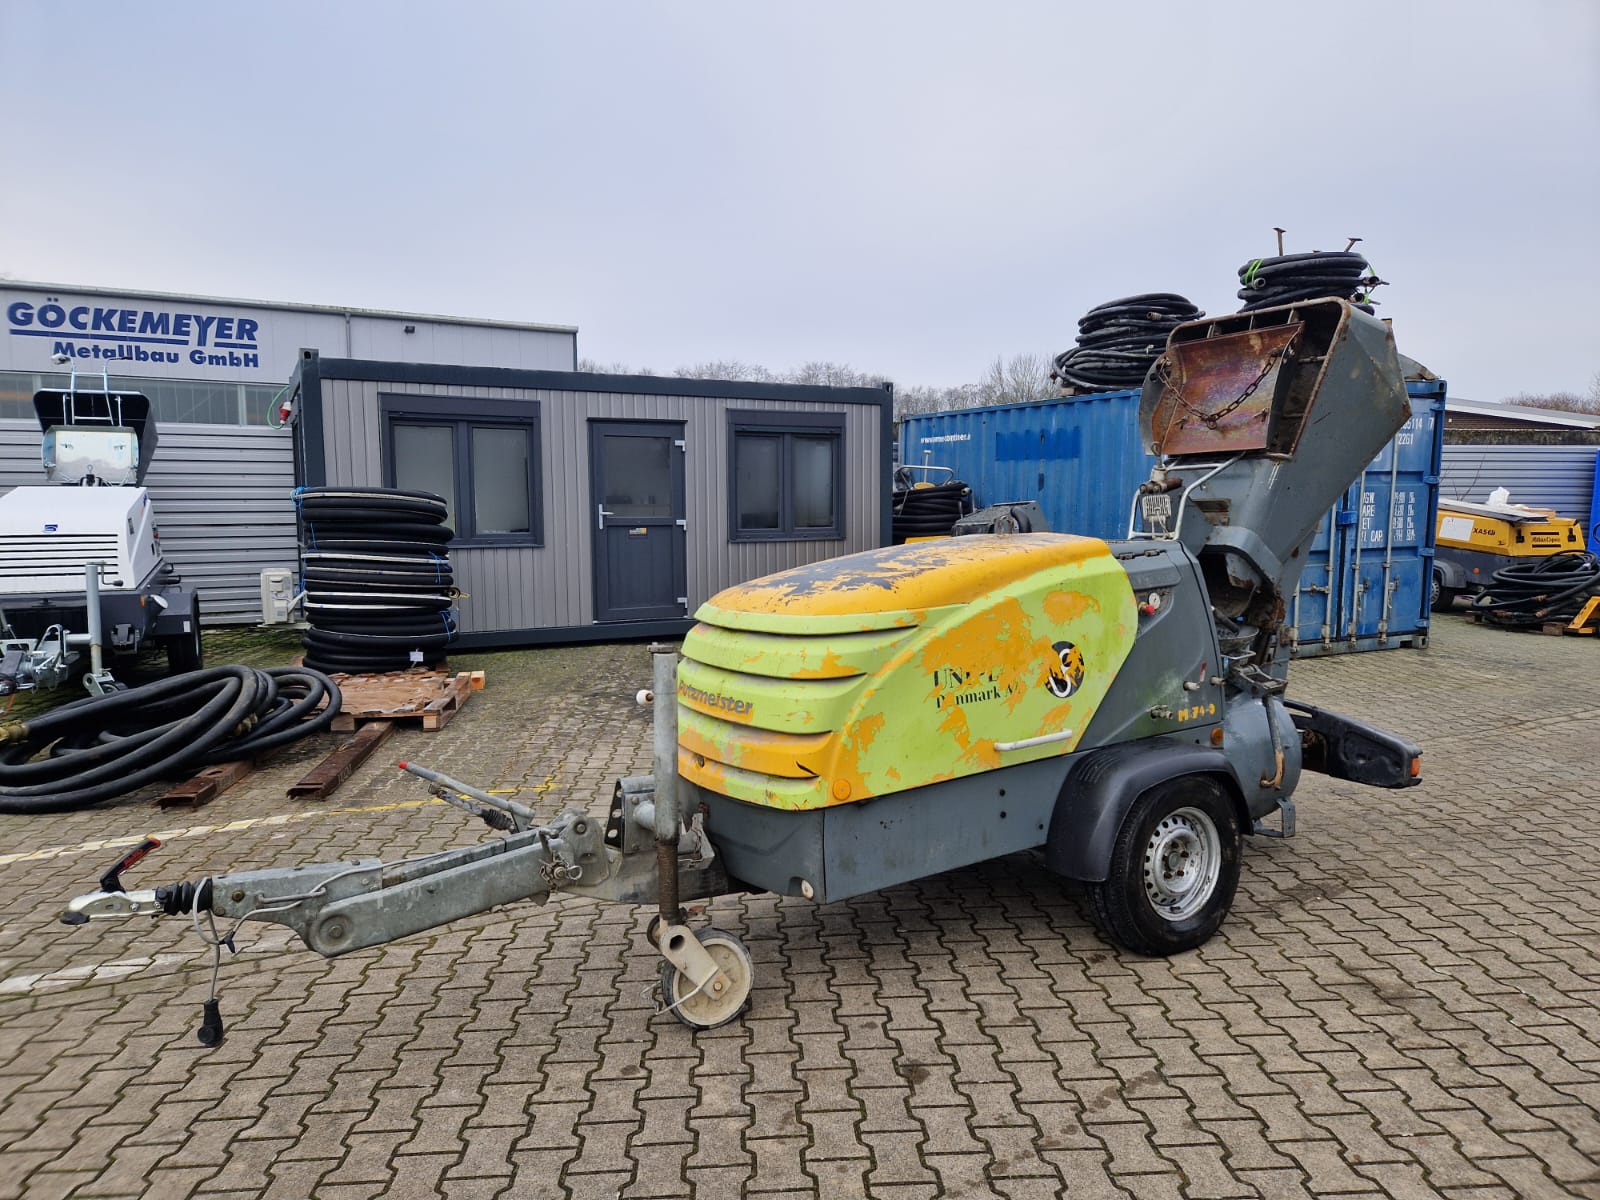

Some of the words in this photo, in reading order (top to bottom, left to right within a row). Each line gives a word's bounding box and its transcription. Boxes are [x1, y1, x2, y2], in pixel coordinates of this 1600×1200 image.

[7, 297, 259, 347] GÖCKEMEYER
[53, 341, 180, 364] Metallbau
[189, 349, 259, 368] GmbH
